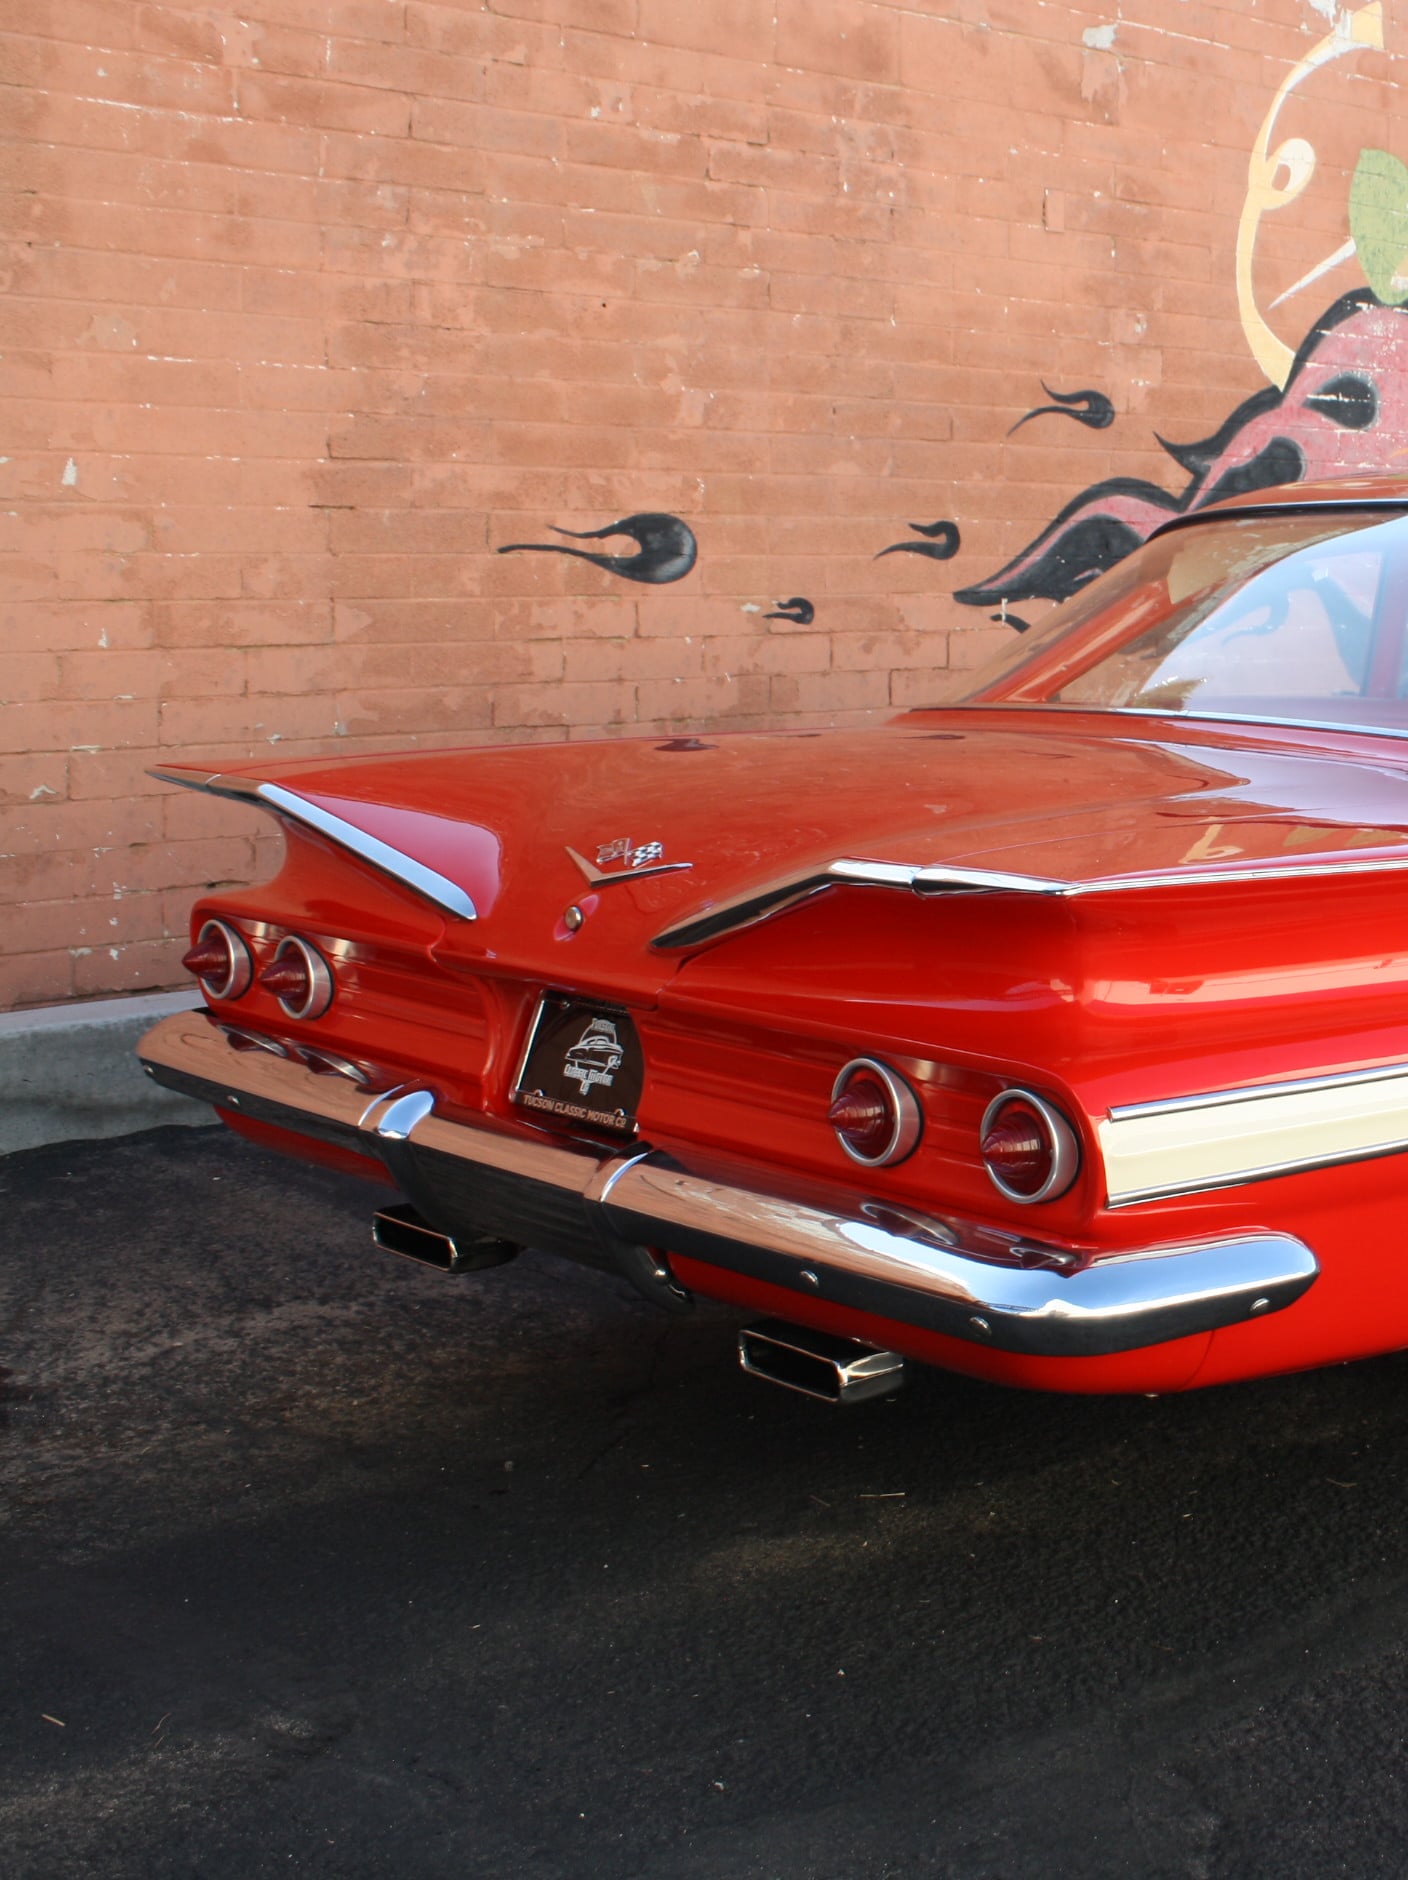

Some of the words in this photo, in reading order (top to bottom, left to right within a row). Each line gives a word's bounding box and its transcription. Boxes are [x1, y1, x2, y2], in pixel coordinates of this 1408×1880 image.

[523, 1096, 554, 1111] TUCSON
[556, 1102, 587, 1119] CLASSIC
[588, 1109, 615, 1126] MOTOR
